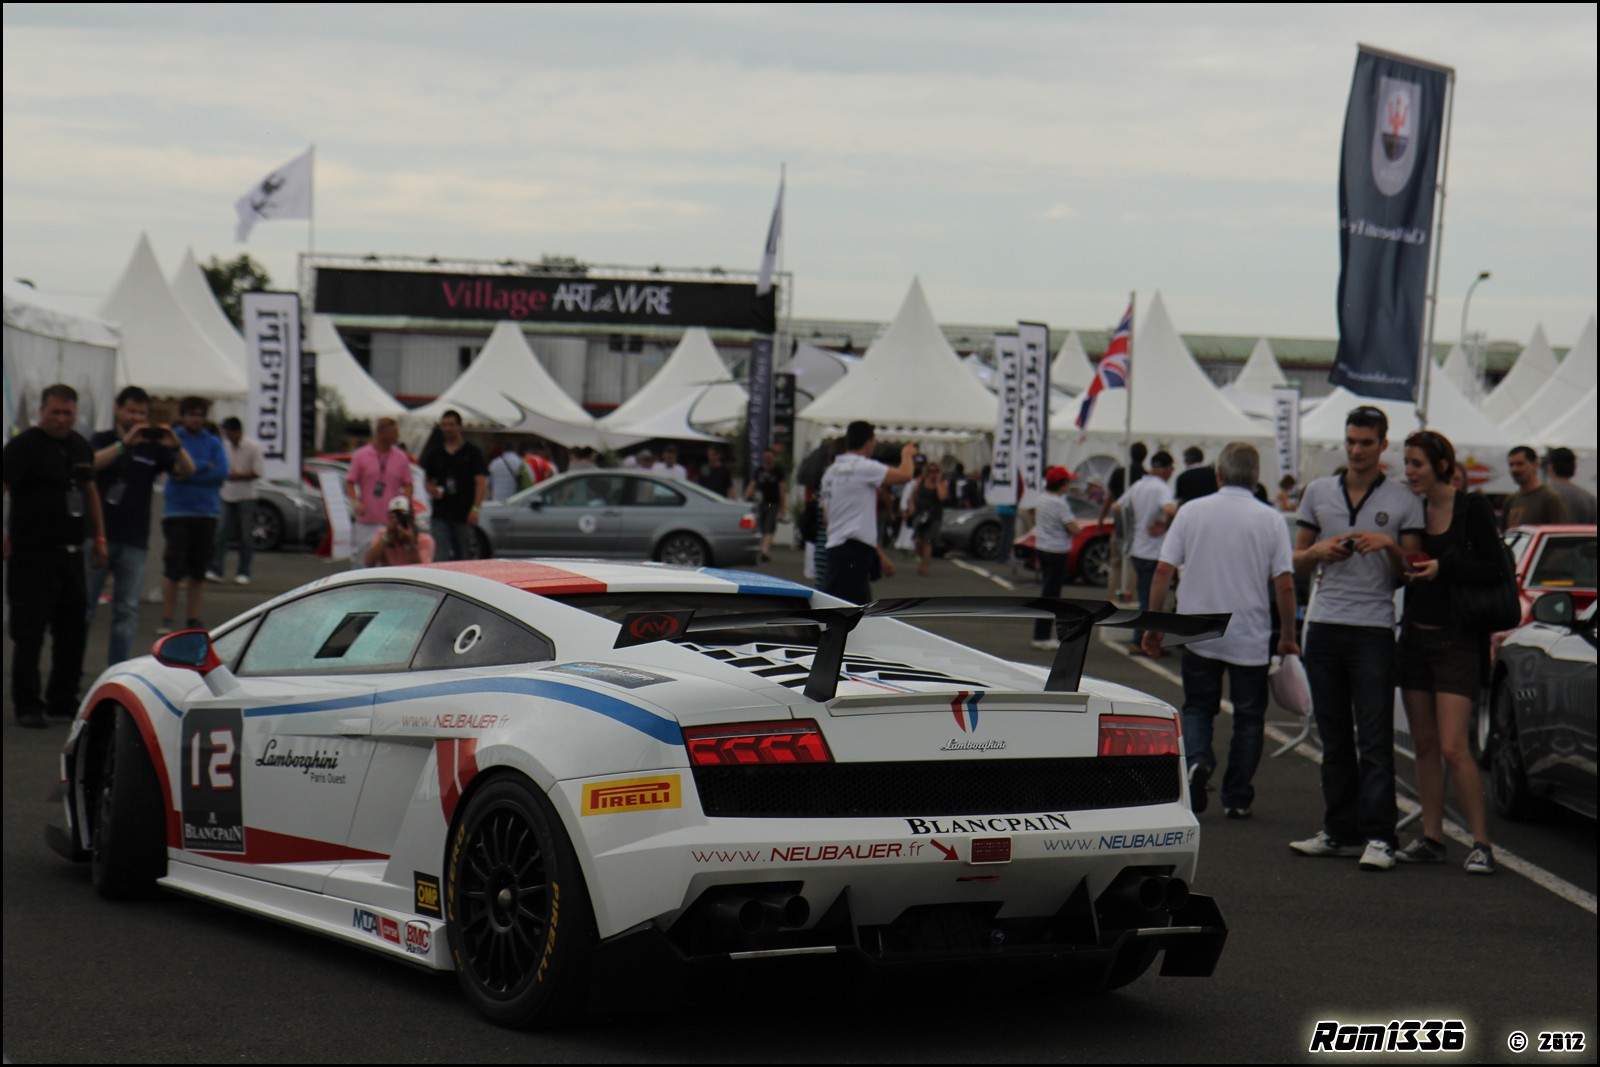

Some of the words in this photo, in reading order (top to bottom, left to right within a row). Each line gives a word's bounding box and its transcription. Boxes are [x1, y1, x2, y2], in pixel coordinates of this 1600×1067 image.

[442, 280, 547, 319] Village
[552, 282, 597, 312] ART
[255, 738, 340, 775] Lamborghini
[940, 738, 1007, 752] Lamborghini
[191, 728, 236, 790] 12
[310, 772, 326, 784] Paris
[327, 773, 346, 785] Ouest
[590, 782, 671, 809] PIRELLI
[691, 841, 924, 863] www.NEUBAUER.fr
[1043, 829, 1195, 852] www.NEUBAUER.fr
[417, 885, 437, 905] OMP
[406, 924, 430, 948] BMC
[537, 881, 560, 983] PIRELLI
